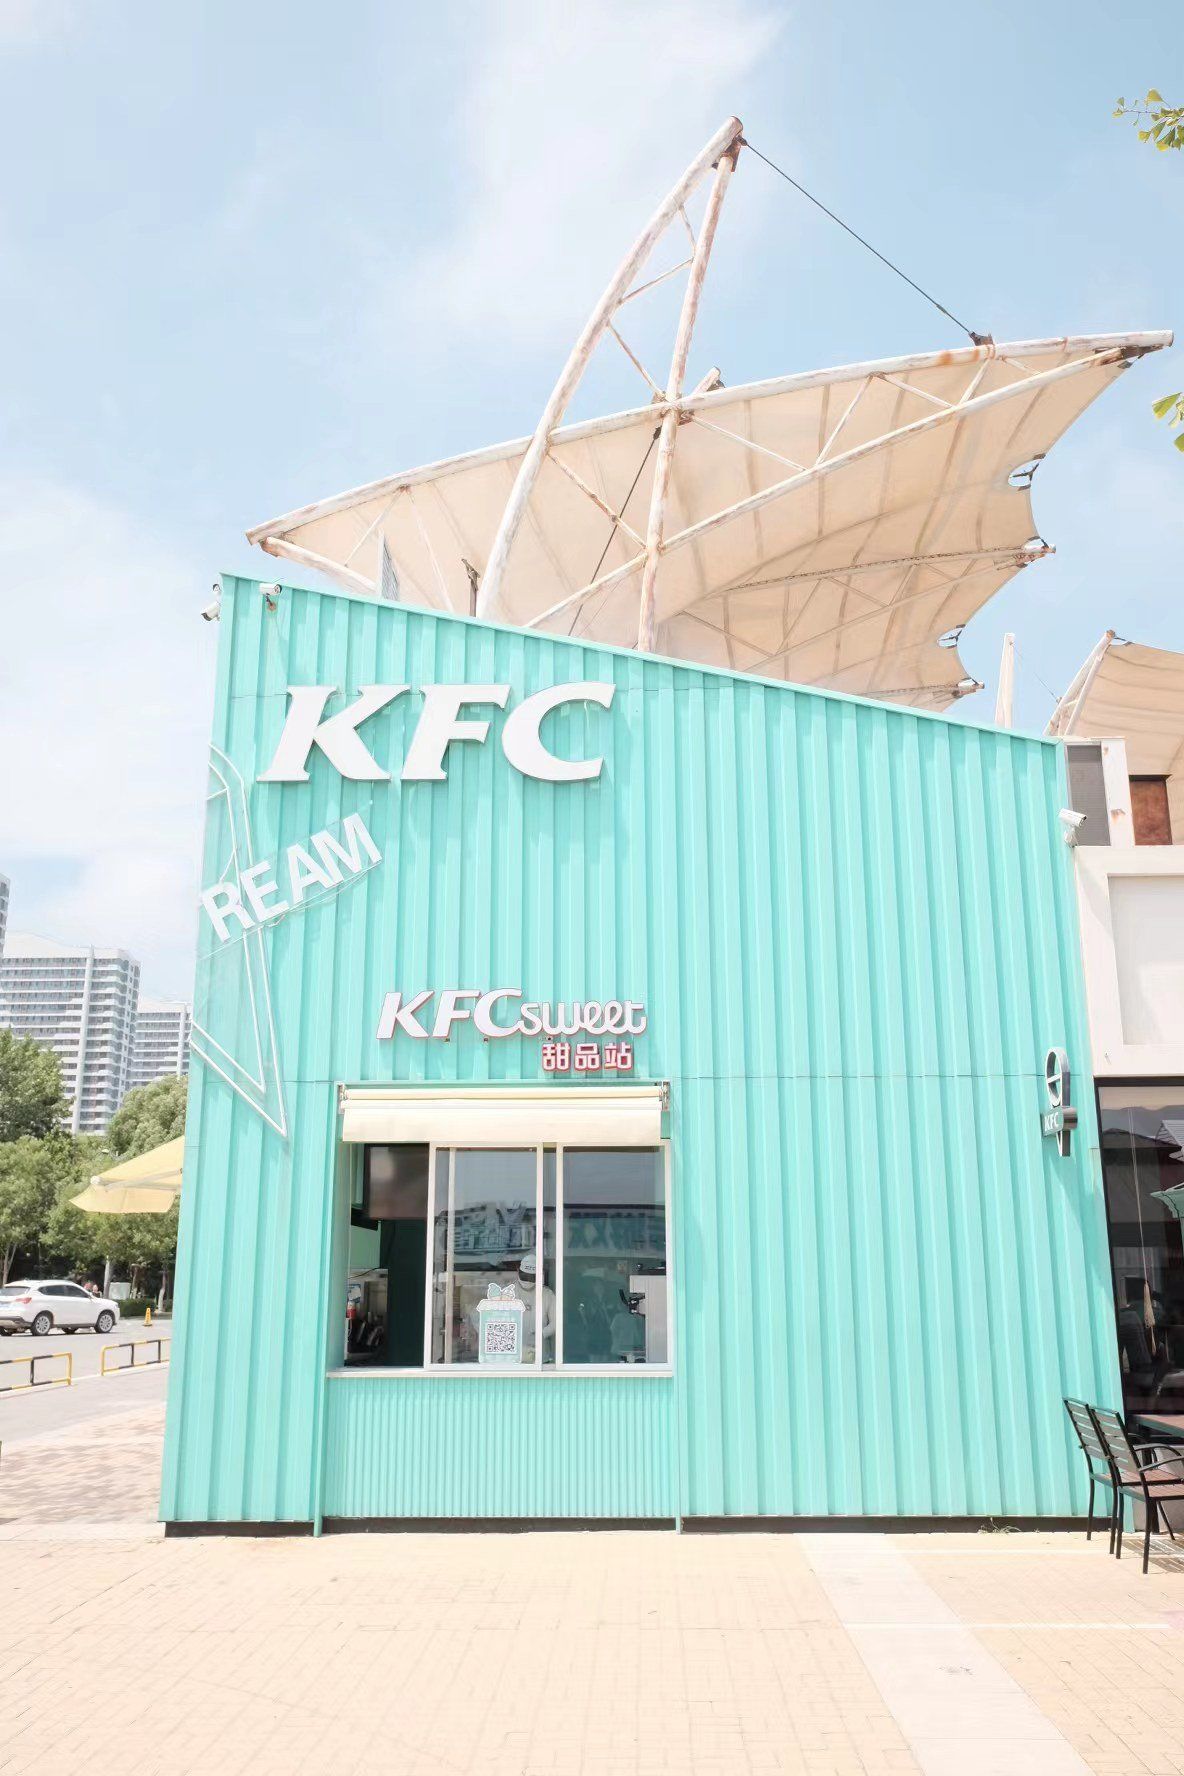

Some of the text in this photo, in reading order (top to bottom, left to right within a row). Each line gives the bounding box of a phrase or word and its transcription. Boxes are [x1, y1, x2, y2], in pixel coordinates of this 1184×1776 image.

[256, 682, 616, 783] KFC
[201, 813, 382, 942] REAM
[541, 1041, 632, 1072] 甜品站
